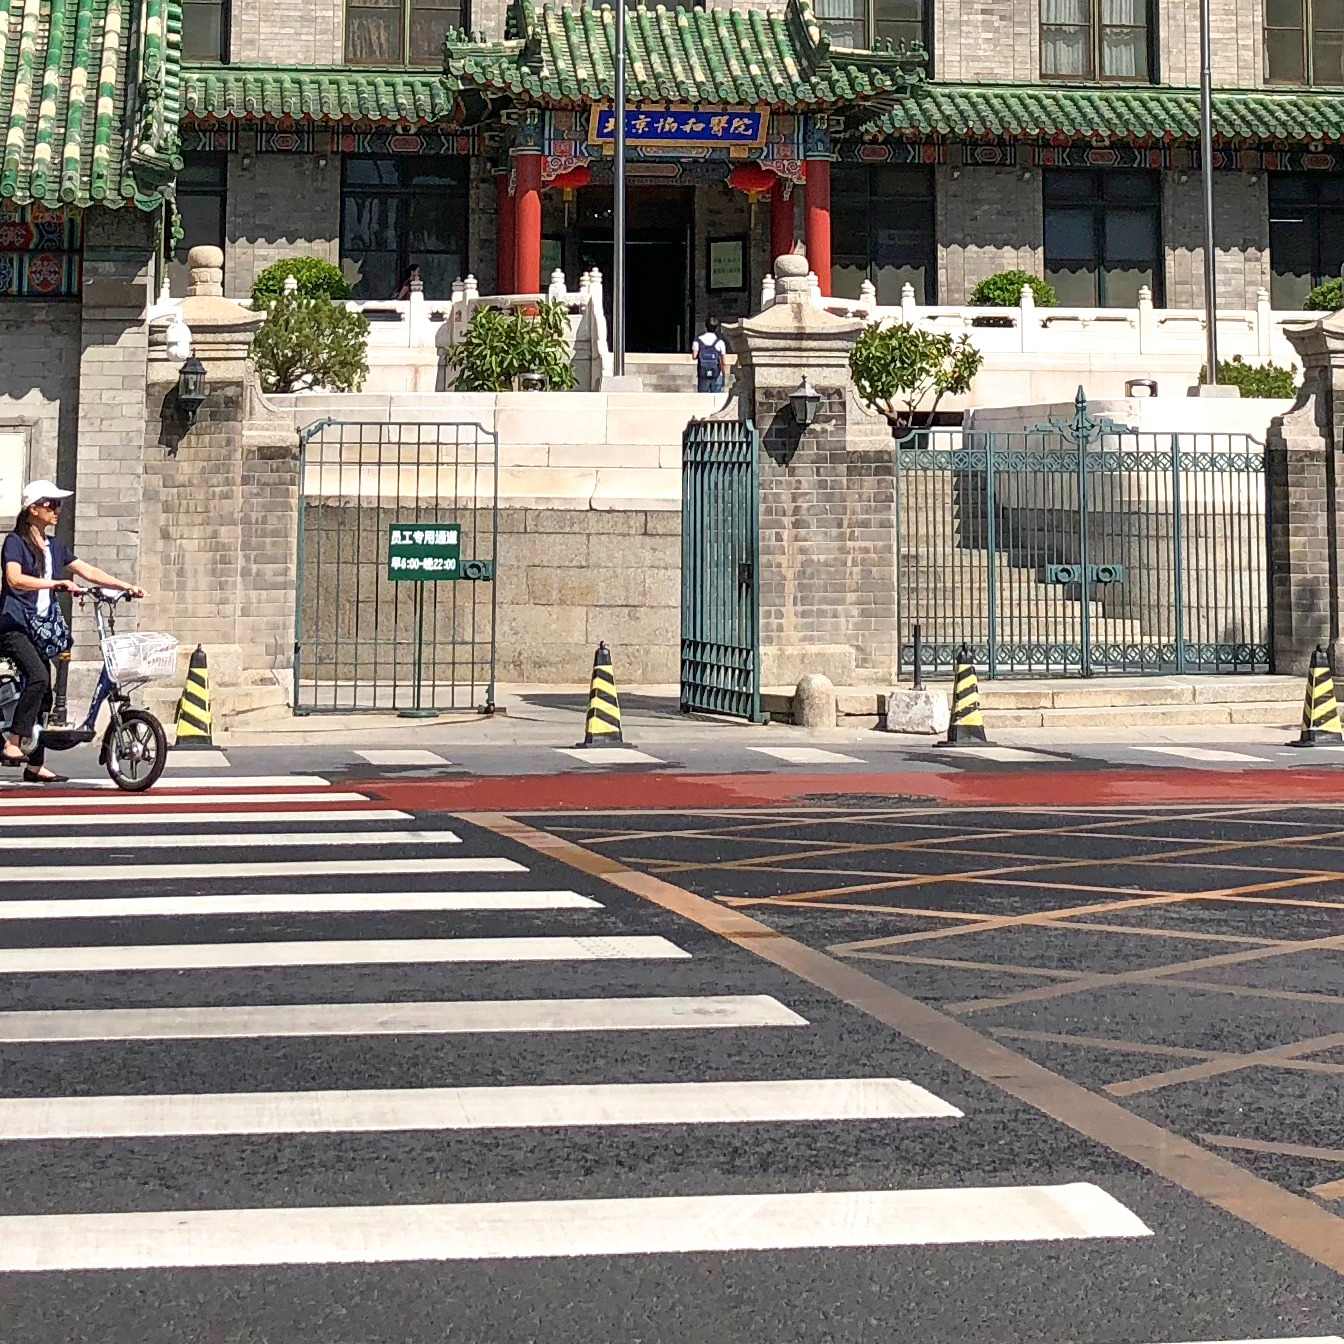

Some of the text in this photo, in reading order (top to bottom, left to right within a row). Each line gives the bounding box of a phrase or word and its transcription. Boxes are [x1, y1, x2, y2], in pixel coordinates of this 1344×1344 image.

[391, 530, 458, 545] 员工专用通道
